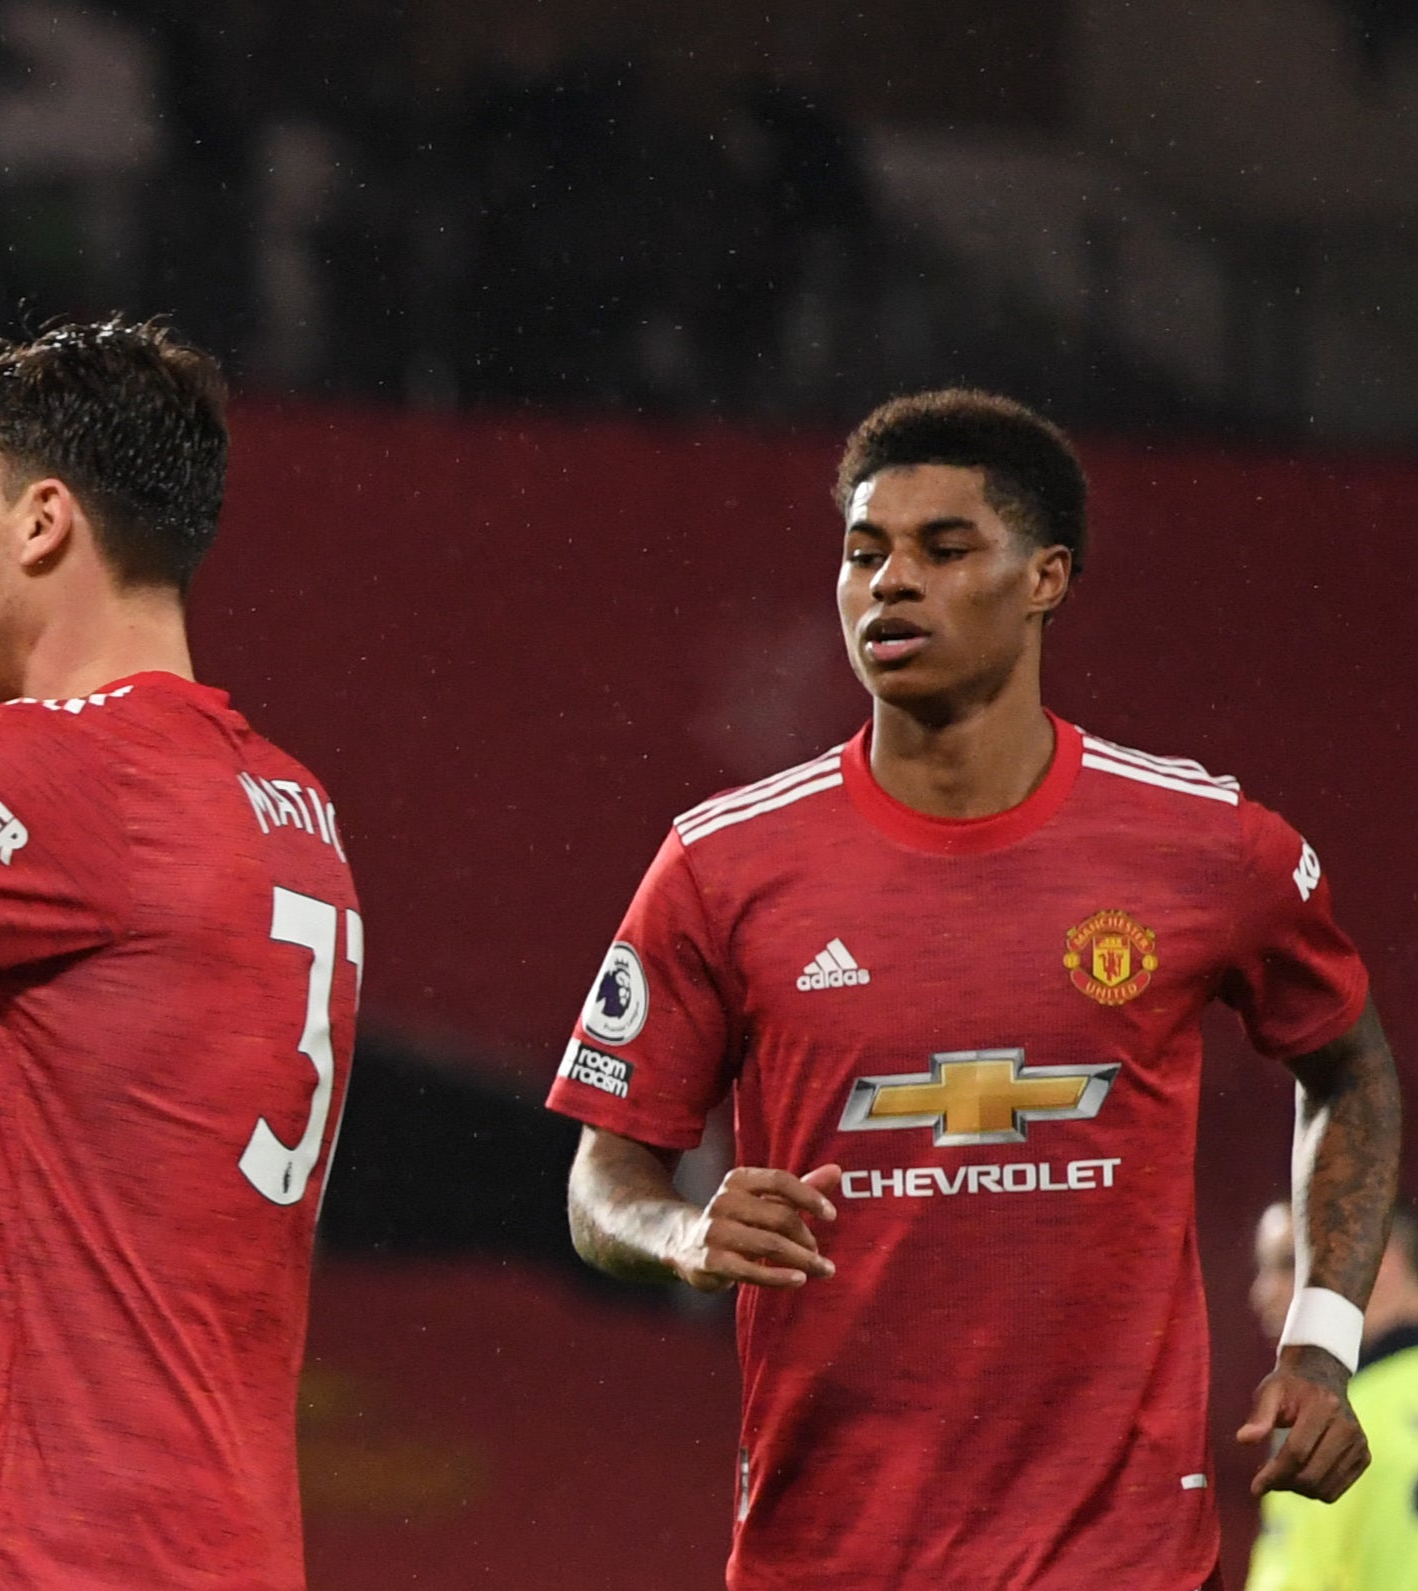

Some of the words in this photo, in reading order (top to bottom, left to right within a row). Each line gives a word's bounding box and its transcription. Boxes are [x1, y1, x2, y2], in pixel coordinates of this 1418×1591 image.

[797, 968, 870, 991] adidas
[1085, 981, 1137, 998] UNITED
[578, 1047, 627, 1080] room
[841, 1158, 1121, 1199] CHEVROLET
